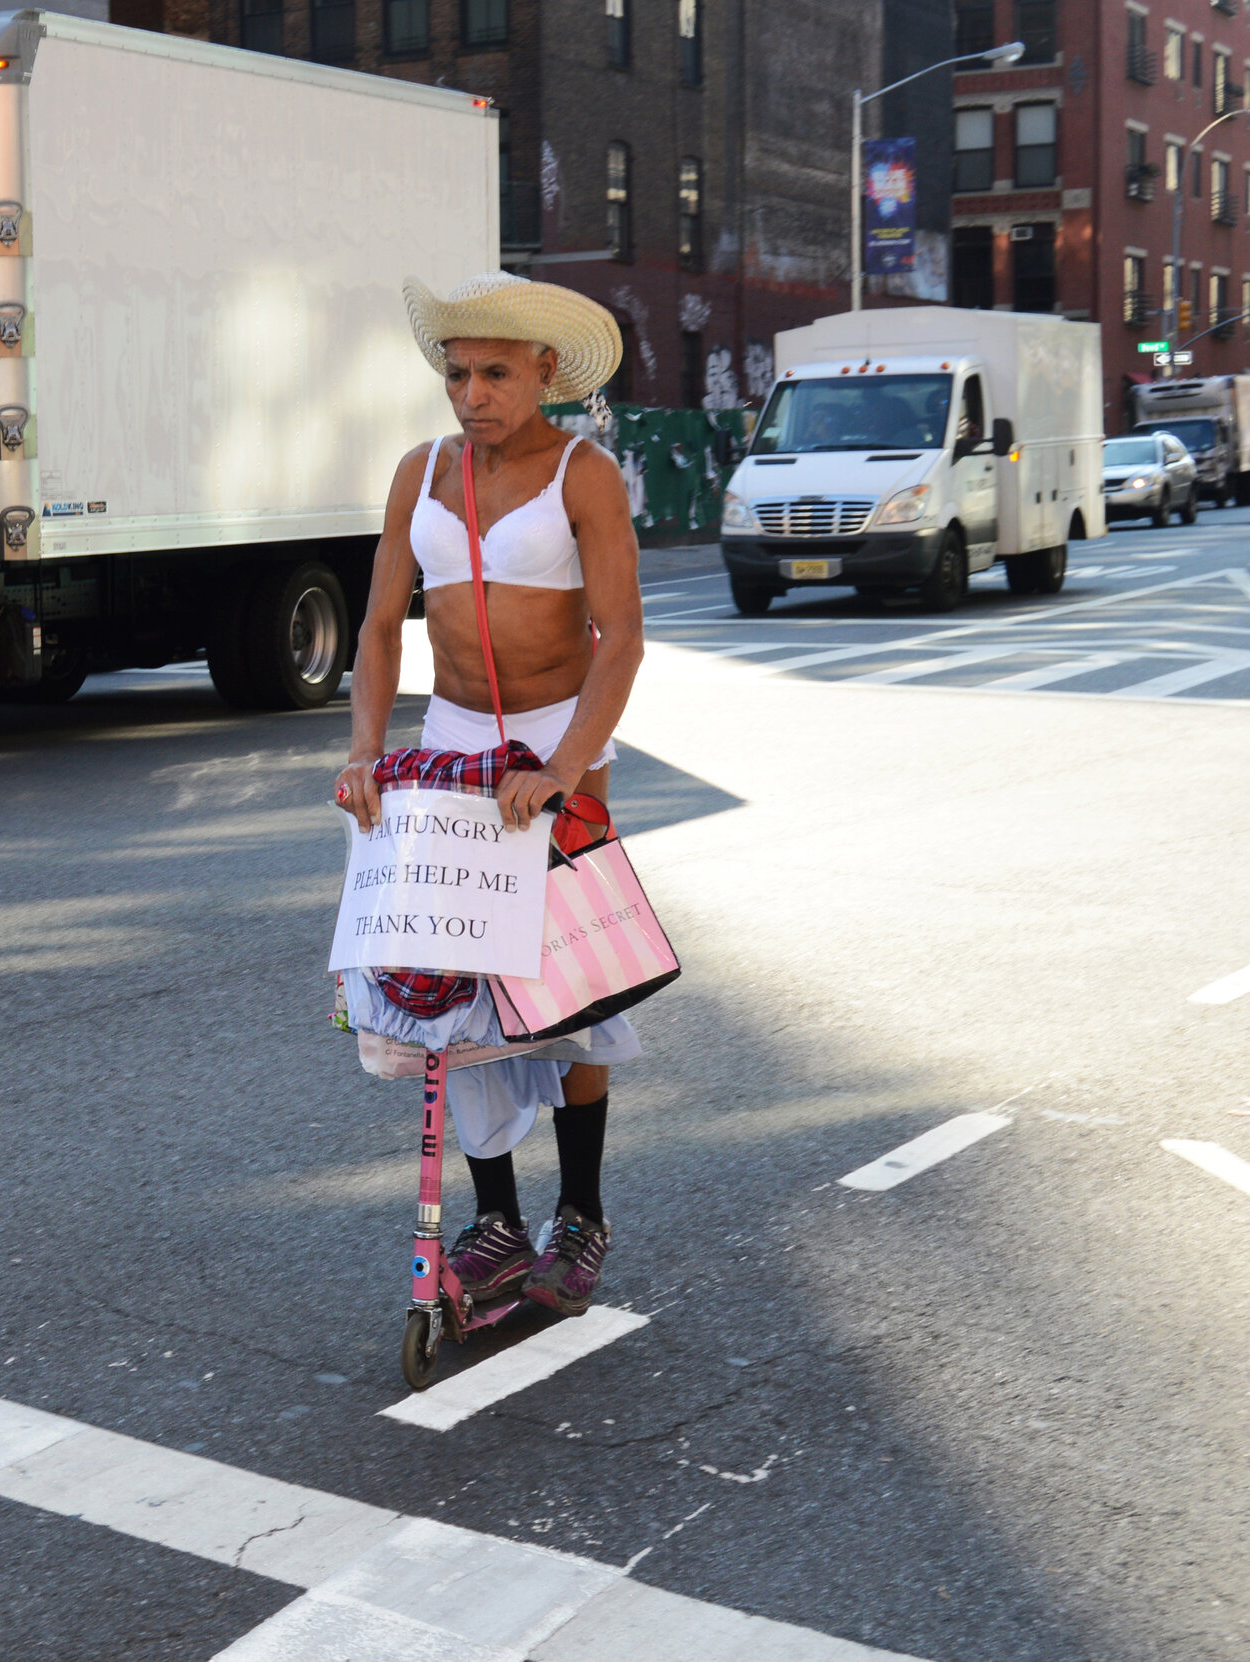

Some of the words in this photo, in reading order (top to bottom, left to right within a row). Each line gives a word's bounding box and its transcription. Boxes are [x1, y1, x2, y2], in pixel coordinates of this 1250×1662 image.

[376, 818, 392, 842] AM
[395, 815, 505, 843] HUNGRY
[353, 864, 398, 891] PLEASE
[403, 864, 470, 887] HELP
[478, 871, 519, 895] ME
[355, 914, 419, 936] THANK
[428, 915, 488, 939] YOU
[590, 903, 642, 932] SECRET
[421, 1053, 440, 1158] micro
